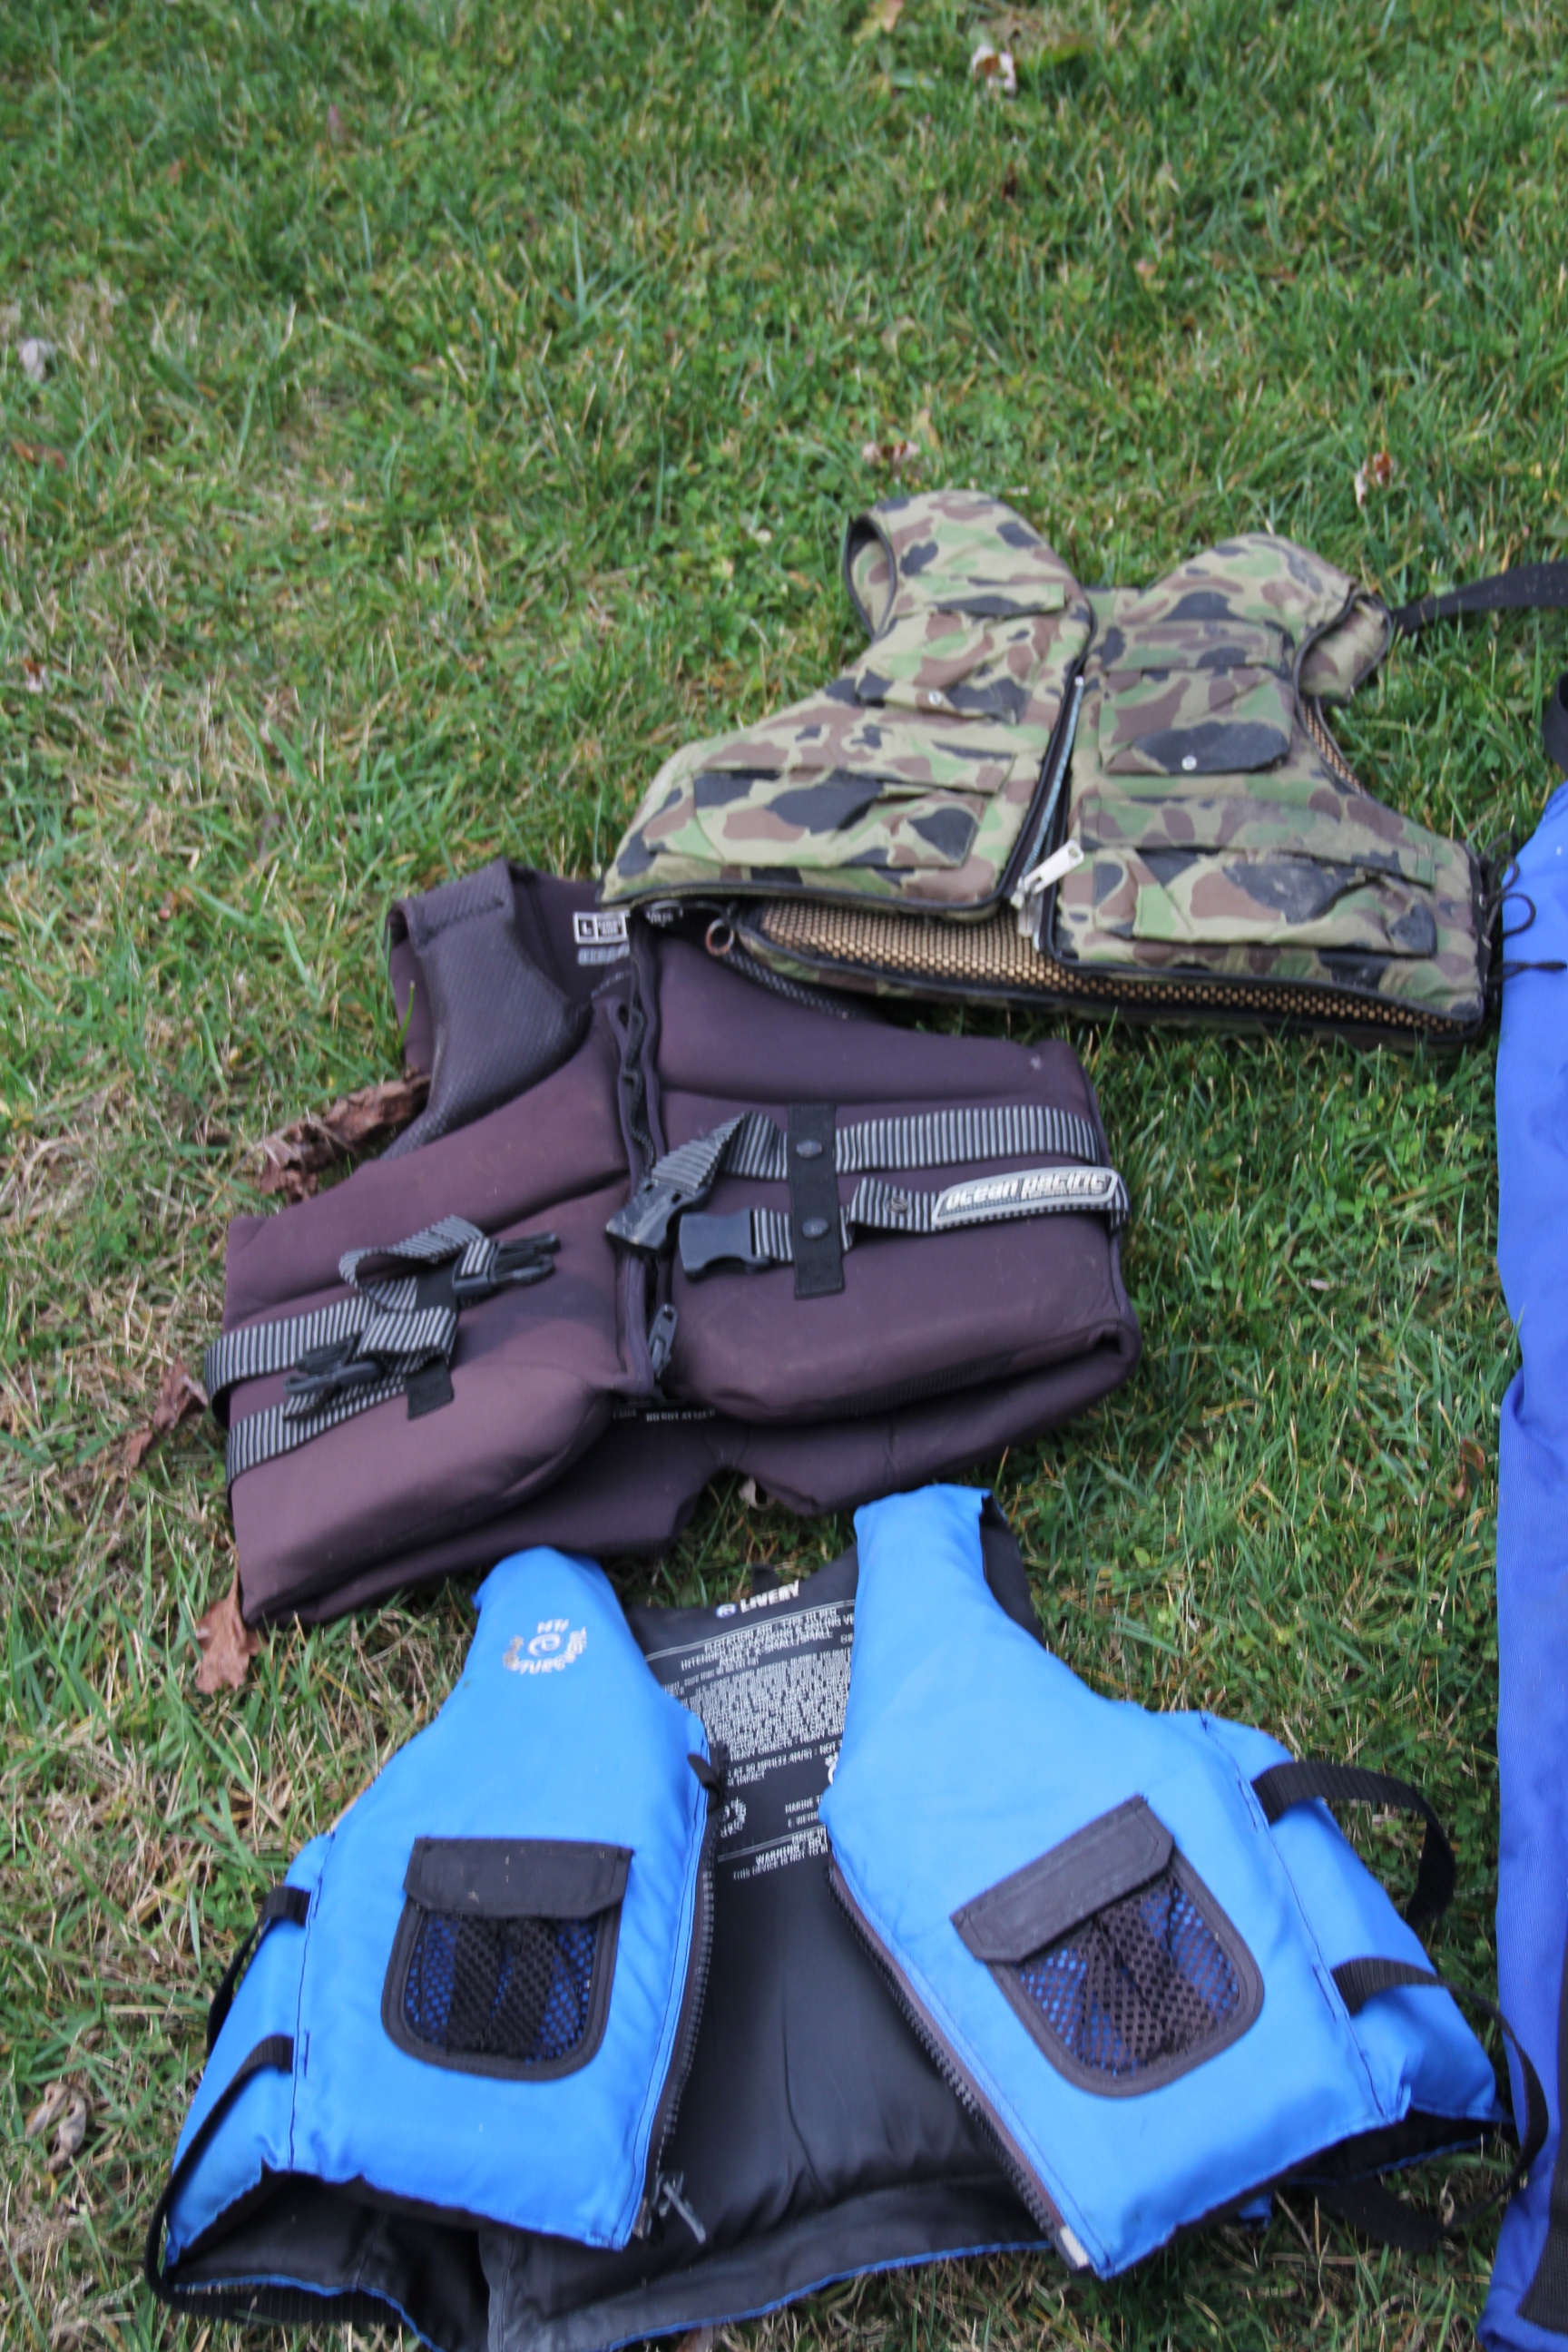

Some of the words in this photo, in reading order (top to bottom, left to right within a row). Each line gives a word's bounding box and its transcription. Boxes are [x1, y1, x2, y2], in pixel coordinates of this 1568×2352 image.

[946, 1179, 1019, 1210] ocean
[1020, 1171, 1107, 1200] pacific
[740, 1579, 799, 1613] LIVERY
